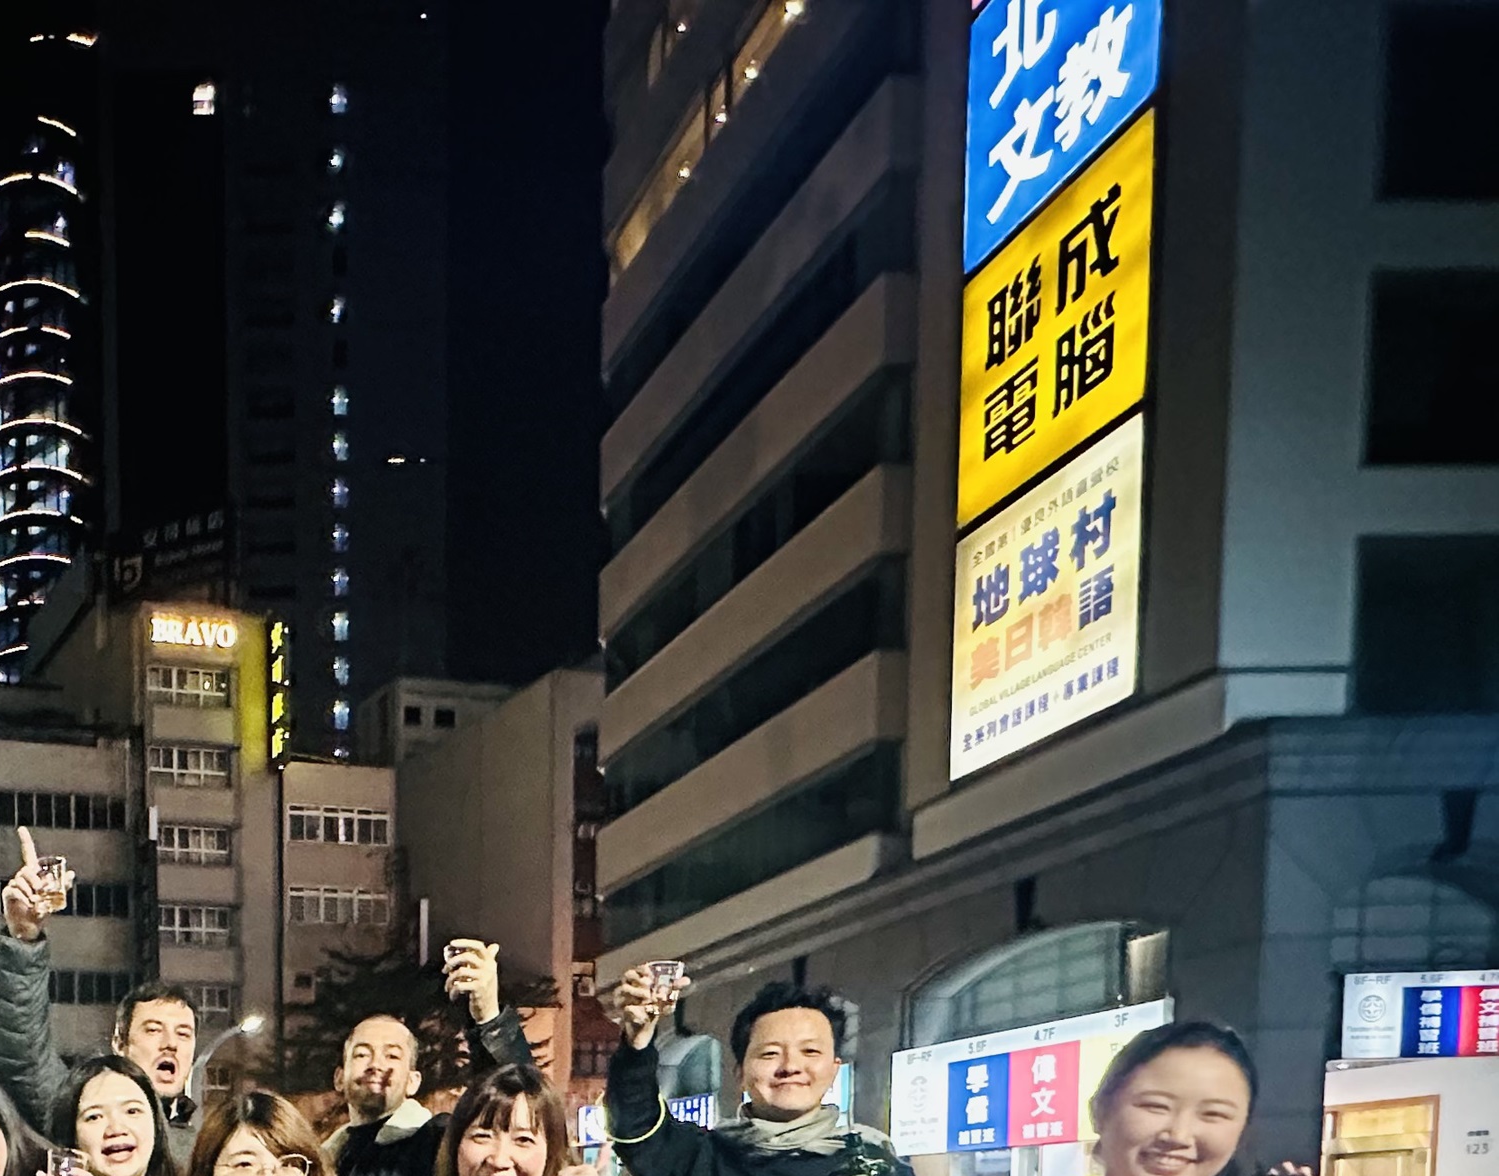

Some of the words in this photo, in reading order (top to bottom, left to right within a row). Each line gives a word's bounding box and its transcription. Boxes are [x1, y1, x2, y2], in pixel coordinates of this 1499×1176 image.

[986, 4, 1132, 225] 文教
[985, 183, 1121, 372] 聯成
[984, 290, 1116, 462] 電腦
[972, 488, 1116, 633] 地球村
[150, 617, 238, 648] BRAVO
[969, 694, 998, 717] GLOBAL
[999, 675, 1031, 700] VILLAGE
[1031, 651, 1076, 683] LANGUAGE
[1077, 631, 1112, 659] CENTER
[970, 565, 1114, 689] 美日韓語
[1033, 1027, 1056, 1040] 4.7F
[1114, 1012, 1129, 1027] 3F
